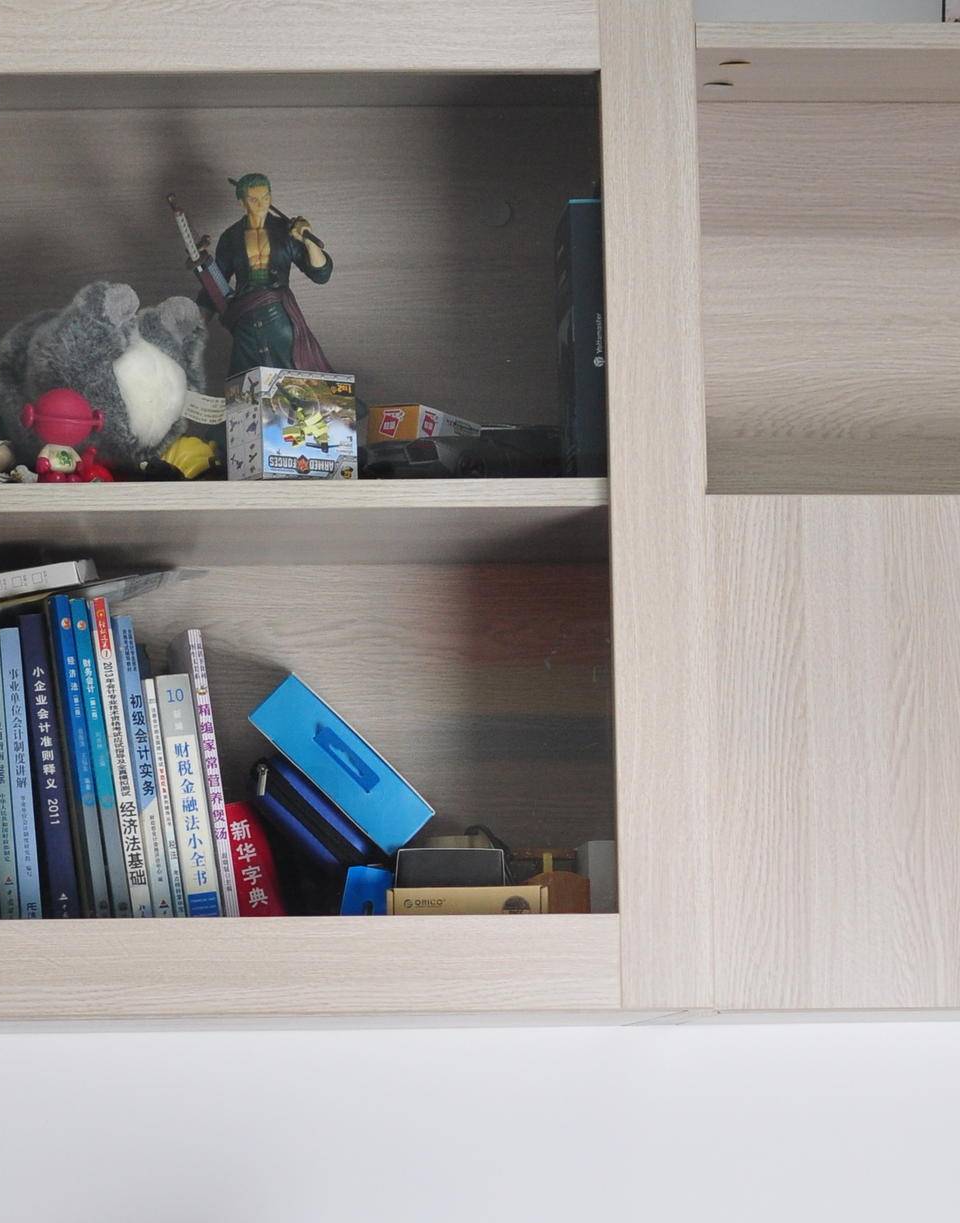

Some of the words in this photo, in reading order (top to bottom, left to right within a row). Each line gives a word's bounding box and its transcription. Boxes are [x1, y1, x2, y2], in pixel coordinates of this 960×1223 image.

[269, 456, 296, 468] FORCES
[309, 459, 334, 471] ARMED
[82, 658, 95, 694] 财务会计
[166, 688, 184, 703] 10
[8, 668, 28, 789] 事业单位会计制度讲解
[32, 666, 58, 790] 小企业会计准则释义
[47, 798, 61, 825] 2011
[130, 693, 155, 796] 初级会计实务
[197, 704, 228, 840] 精编家常营养煲汤
[119, 801, 147, 886] 经济法基础
[174, 742, 207, 887] 财税金融法小全书
[229, 819, 268, 908] 新华字典
